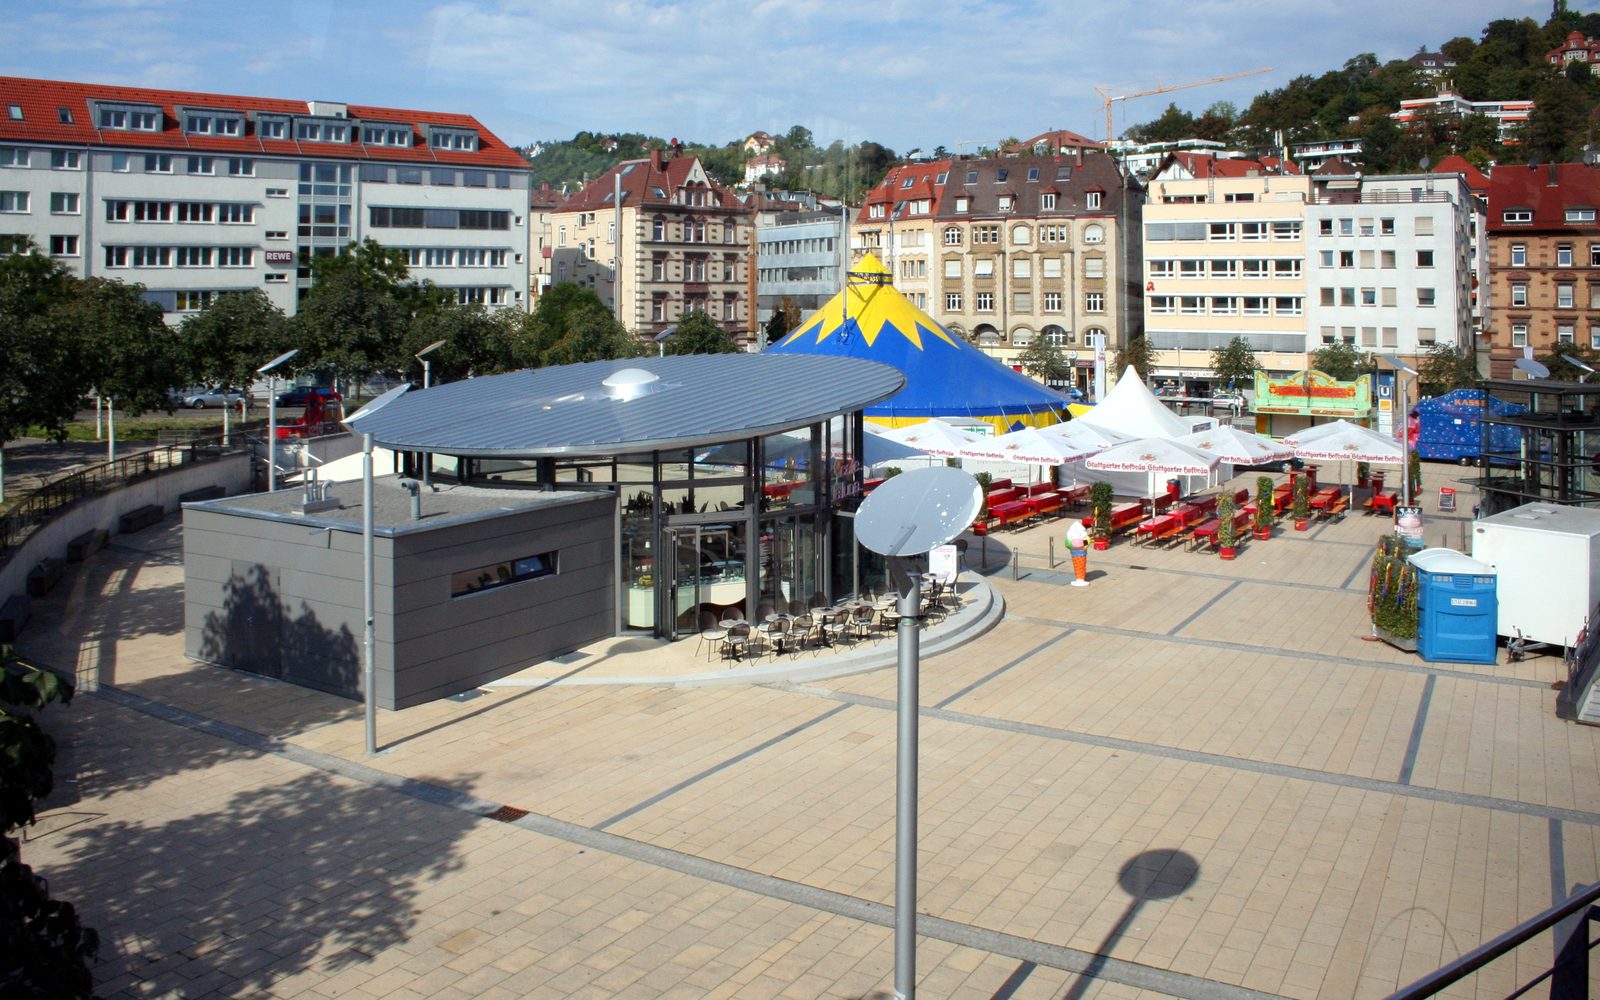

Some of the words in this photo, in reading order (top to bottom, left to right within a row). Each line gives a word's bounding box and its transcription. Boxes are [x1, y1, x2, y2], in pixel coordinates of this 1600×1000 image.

[266, 252, 291, 260] REWE
[1380, 386, 1390, 396] U
[1295, 450, 1327, 459] Stuttgarter
[1351, 453, 1384, 461] Stuttgarter
[1086, 461, 1121, 470] Stuttgarter
[1147, 465, 1182, 474] Stuttgarter
